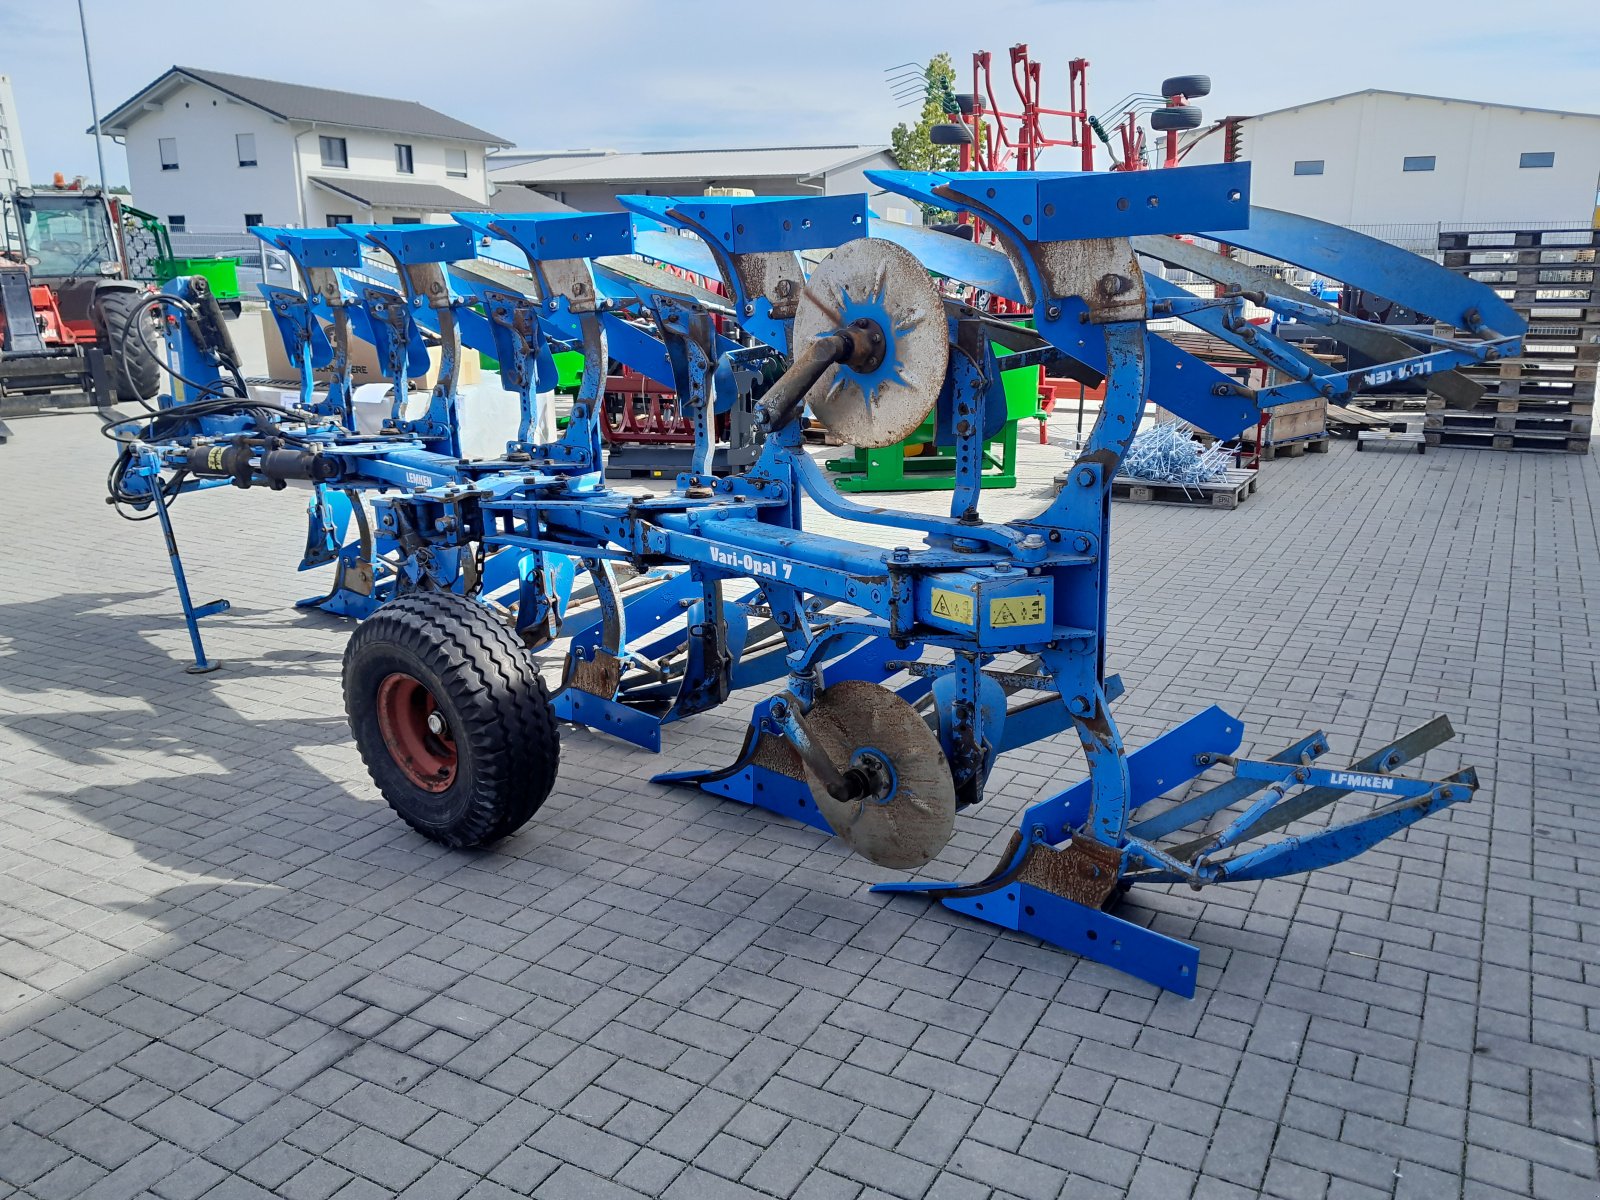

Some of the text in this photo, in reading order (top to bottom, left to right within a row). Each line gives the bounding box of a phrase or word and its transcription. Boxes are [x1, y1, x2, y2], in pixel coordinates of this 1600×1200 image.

[405, 471, 433, 487] LEMKEN
[709, 546, 793, 580] Vari-Opal 7
